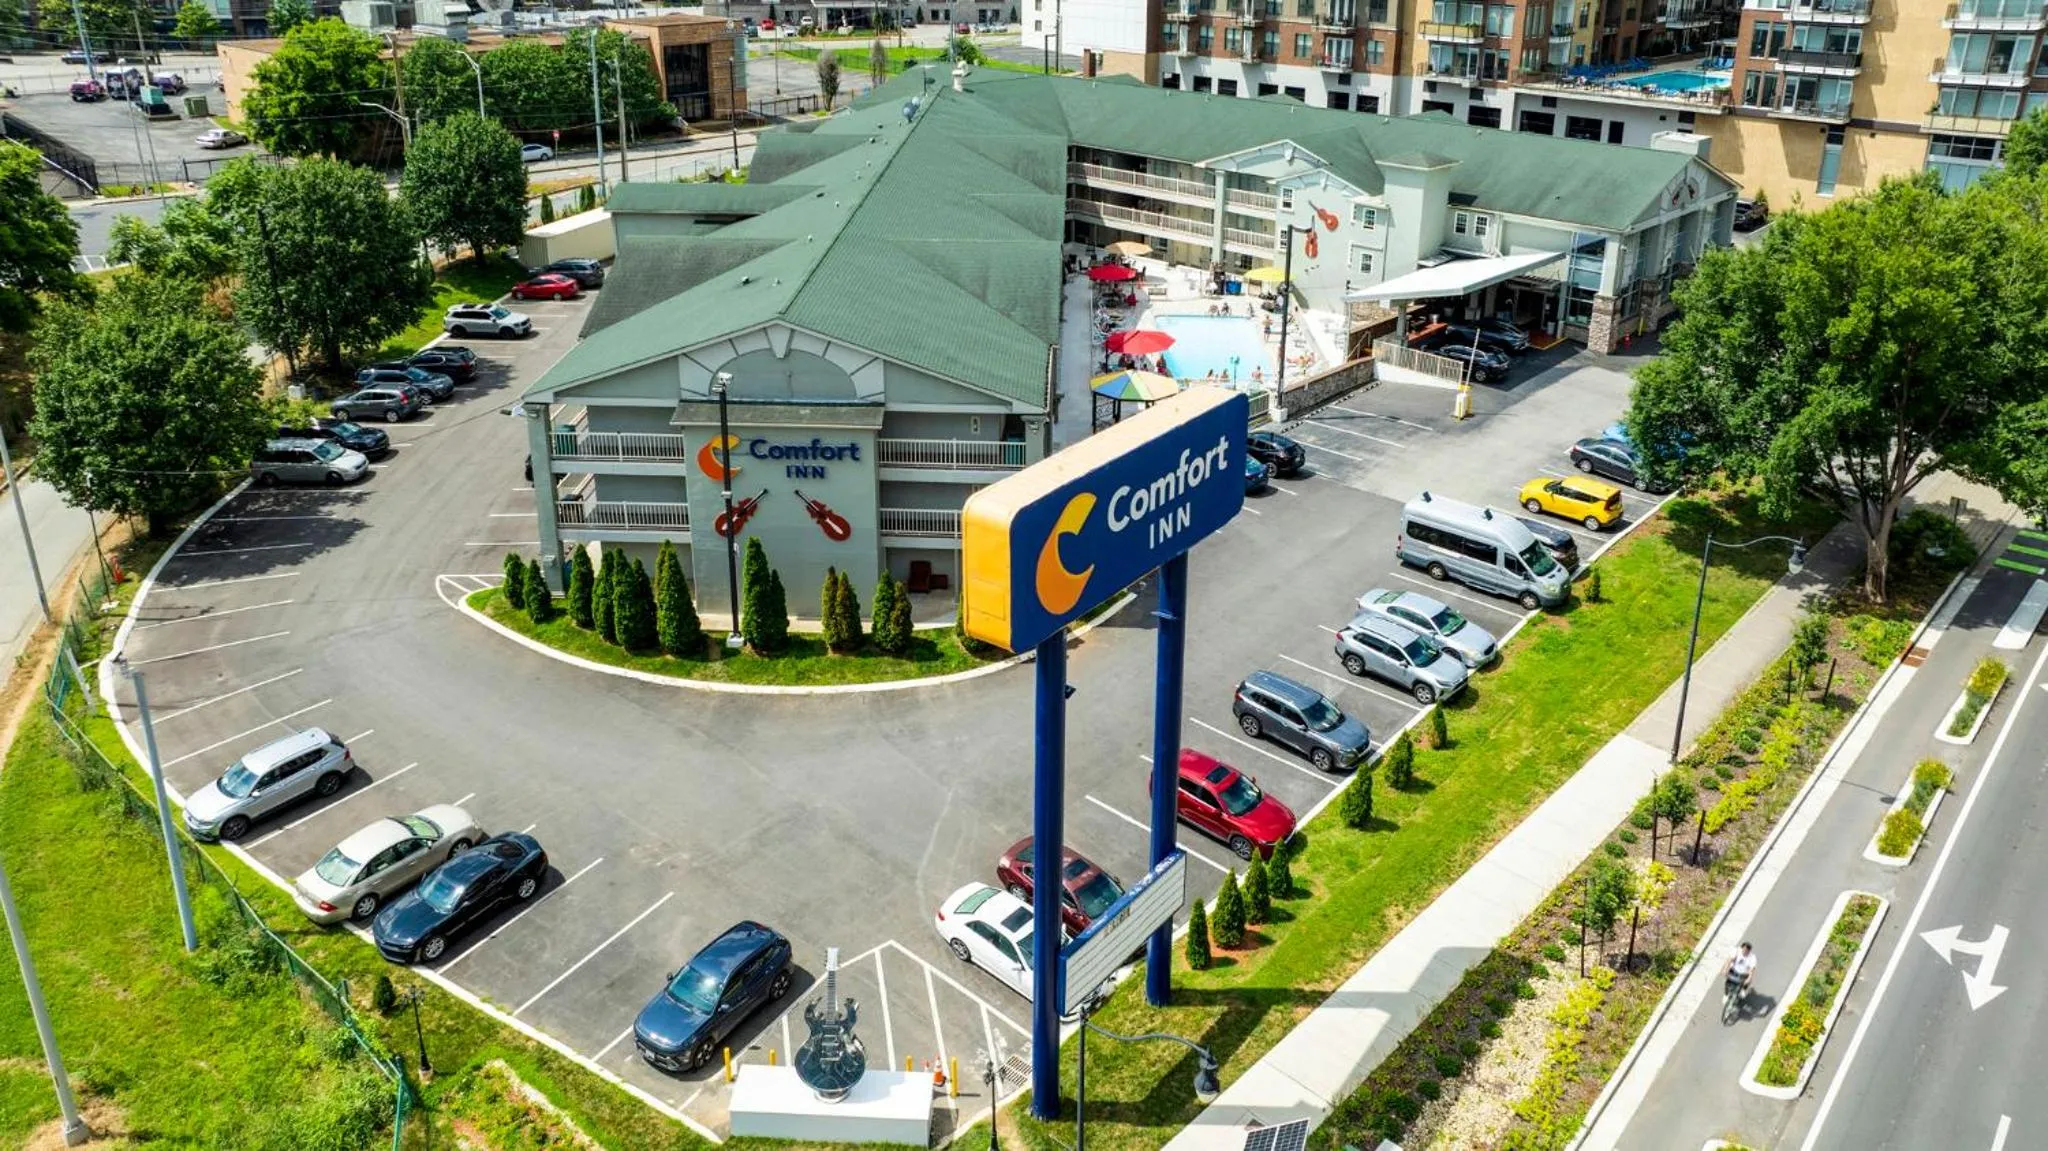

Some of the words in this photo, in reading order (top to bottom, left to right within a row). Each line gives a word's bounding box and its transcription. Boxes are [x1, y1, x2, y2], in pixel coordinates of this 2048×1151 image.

[750, 438, 860, 461] Comfort
[786, 465, 826, 479] INN
[1107, 435, 1229, 532] Comfort
[1149, 502, 1191, 549] INN
